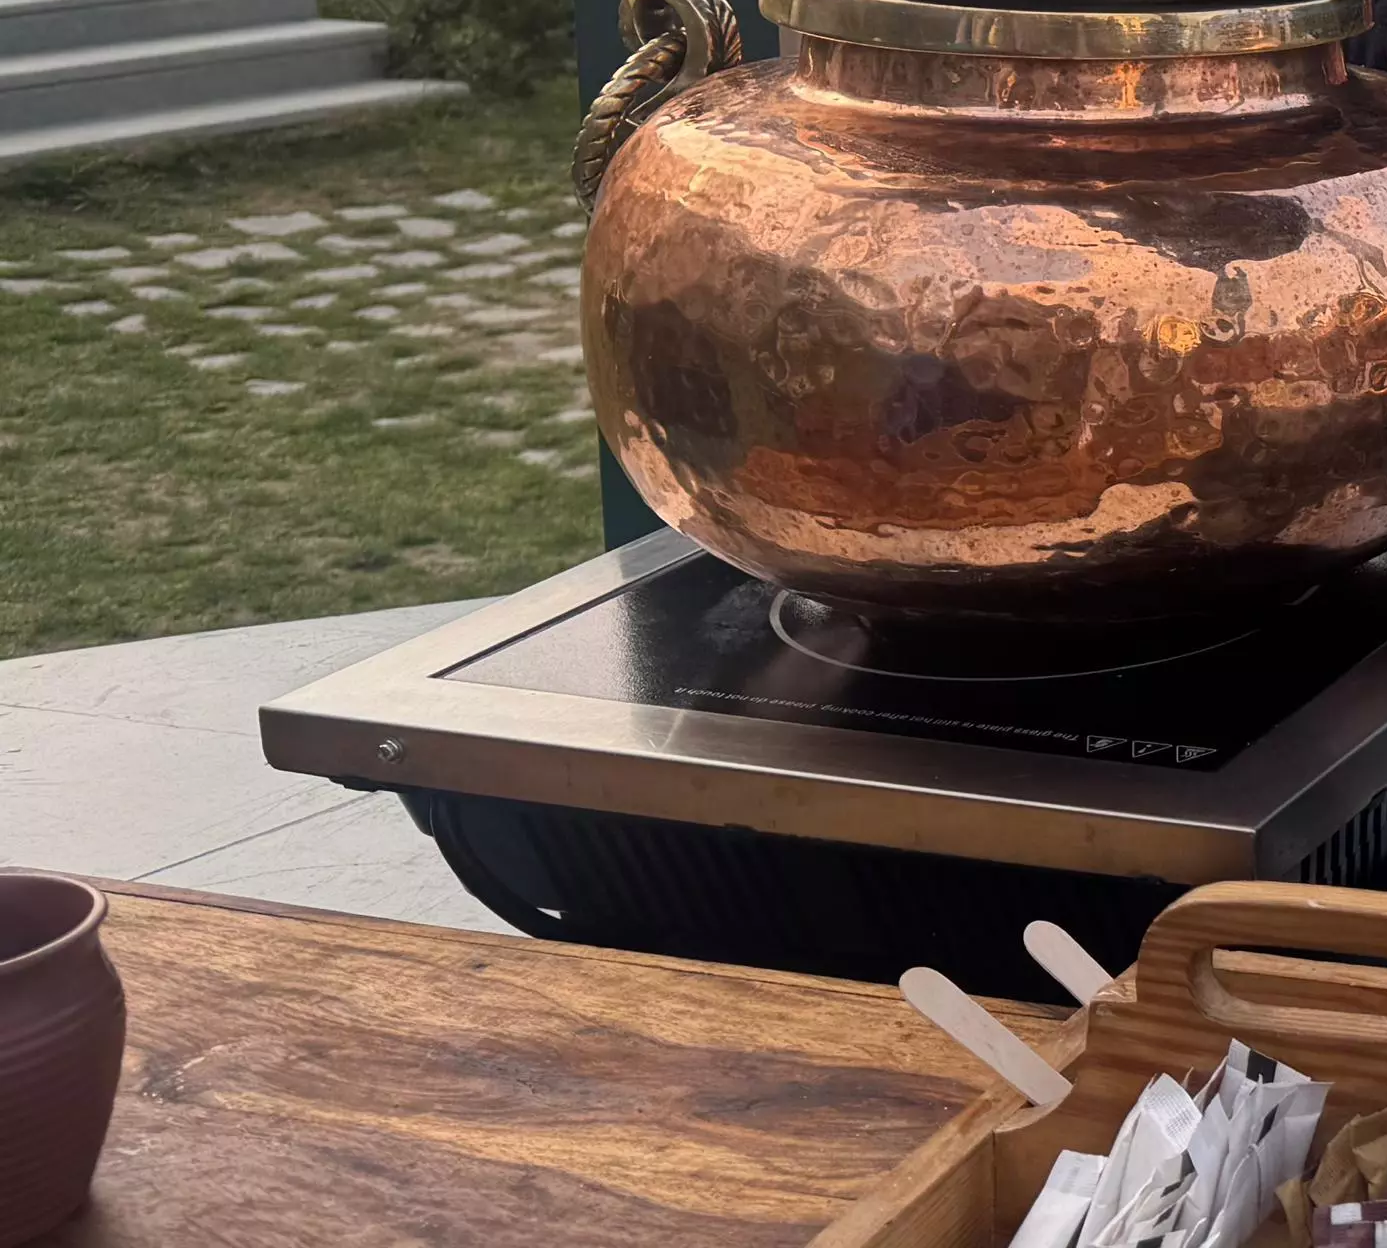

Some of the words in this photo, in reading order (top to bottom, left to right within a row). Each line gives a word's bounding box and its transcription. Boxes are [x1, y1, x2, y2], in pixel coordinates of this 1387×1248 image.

[687, 688, 724, 697] touch
[875, 712, 909, 720] after
[908, 716, 933, 724] hot
[975, 724, 1013, 732] plate
[1013, 728, 1053, 736] glass
[1053, 733, 1079, 741] The
